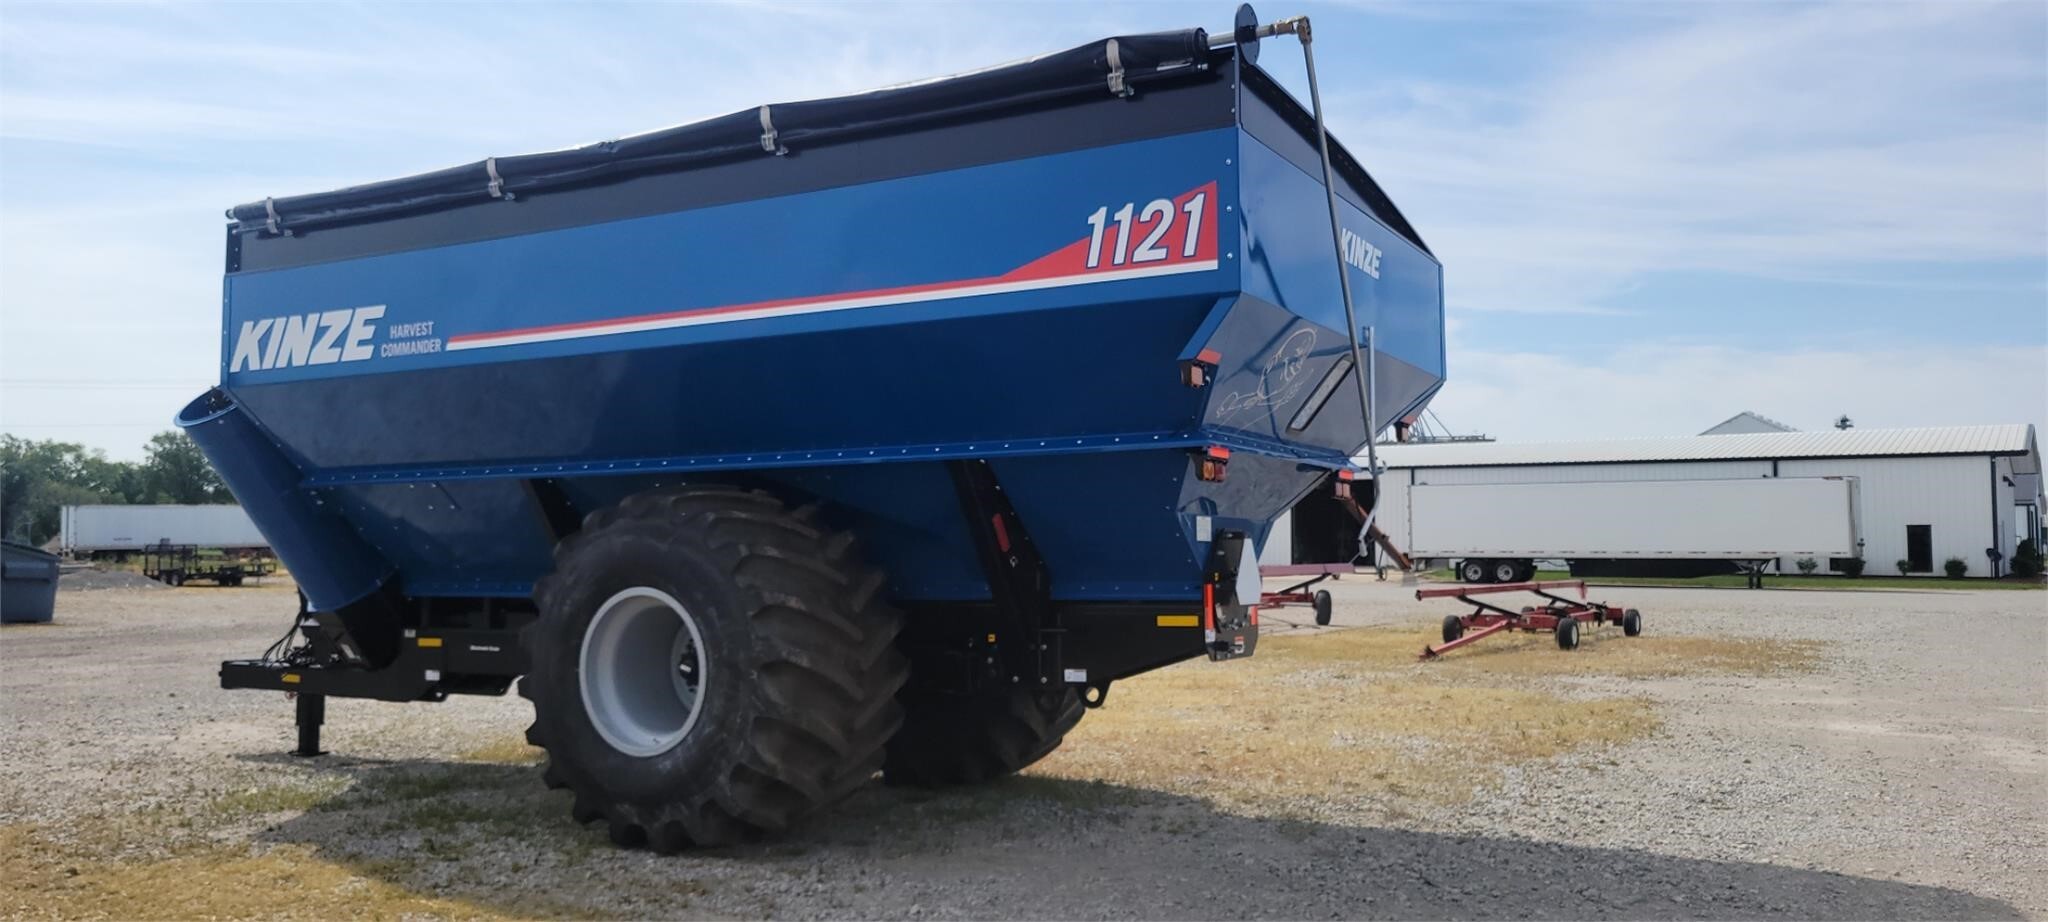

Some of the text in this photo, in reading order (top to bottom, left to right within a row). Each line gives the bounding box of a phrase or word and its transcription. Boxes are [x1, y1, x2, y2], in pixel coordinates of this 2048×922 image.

[1086, 192, 1206, 269] 1121
[1341, 227, 1382, 280] KINZE
[229, 304, 387, 374] KINZE
[381, 338, 442, 358] COMMANDER
[390, 321, 434, 339] HARVEST
